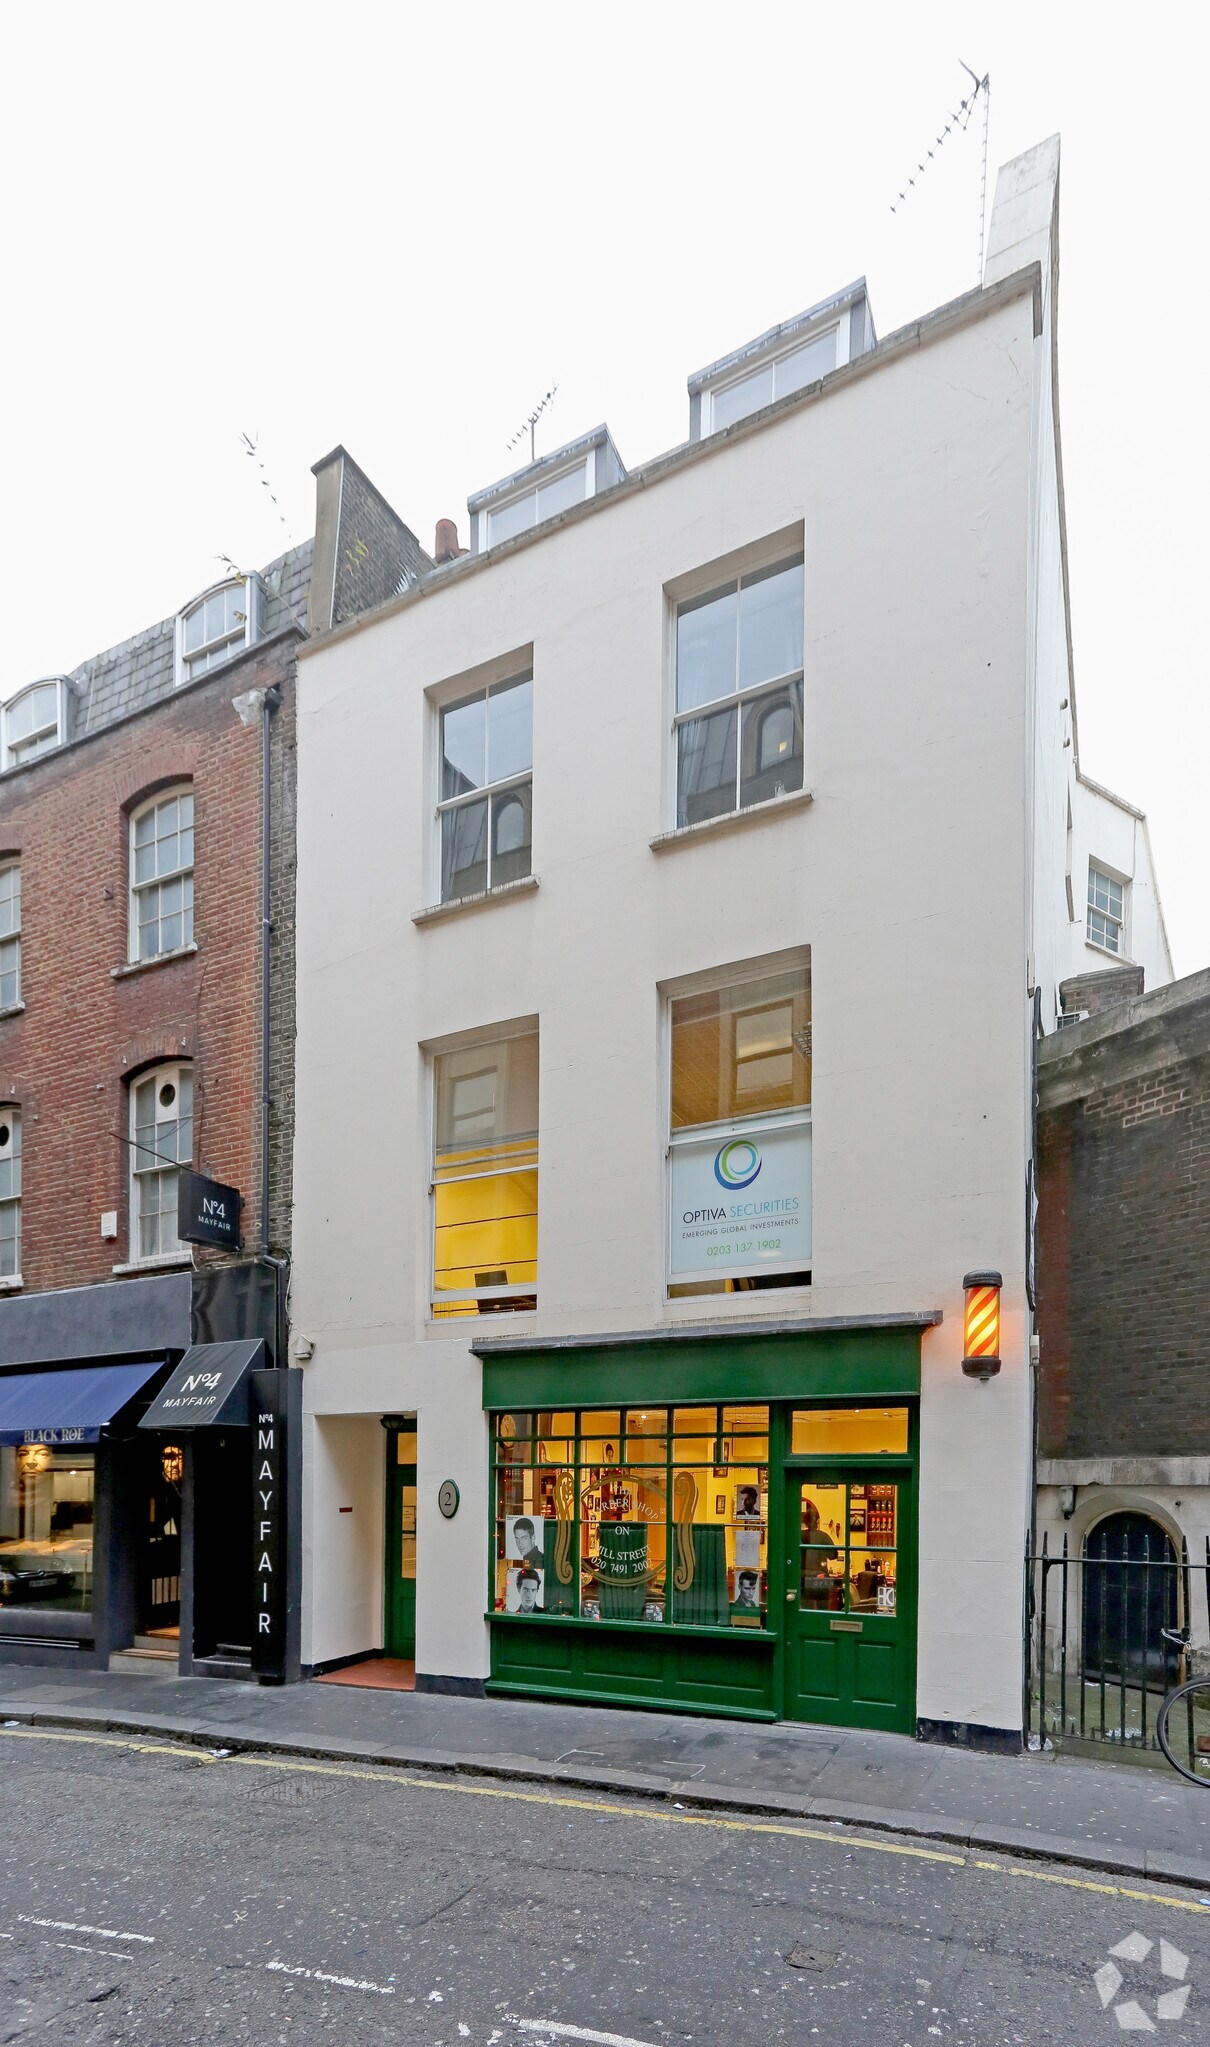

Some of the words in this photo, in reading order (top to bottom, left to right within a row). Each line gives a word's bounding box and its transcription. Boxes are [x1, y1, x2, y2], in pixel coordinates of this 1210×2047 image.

[683, 1208, 727, 1224] OPTIVA
[729, 1196, 800, 1219] SECURITIES
[198, 1215, 231, 1231] MAYFAIR
[682, 1228, 719, 1239] EMERGING
[721, 1225, 748, 1235] GLOBAL
[750, 1218, 800, 1231] INVESTMENTS
[707, 1245, 731, 1257] 0203
[736, 1242, 753, 1253] 137
[758, 1239, 782, 1251] 1902
[162, 1396, 217, 1408] MAYFAIR
[24, 1429, 59, 1443] BLACK
[61, 1427, 85, 1441] ROE
[444, 1492, 452, 1506] 2
[593, 1498, 630, 1514] ARBER
[633, 1501, 659, 1519] HOP
[258, 1429, 275, 1634] MAYFAIR
[615, 1526, 630, 1536] ON
[616, 1544, 652, 1561] STREET
[590, 1556, 607, 1570] 020
[610, 1563, 628, 1574] 7491
